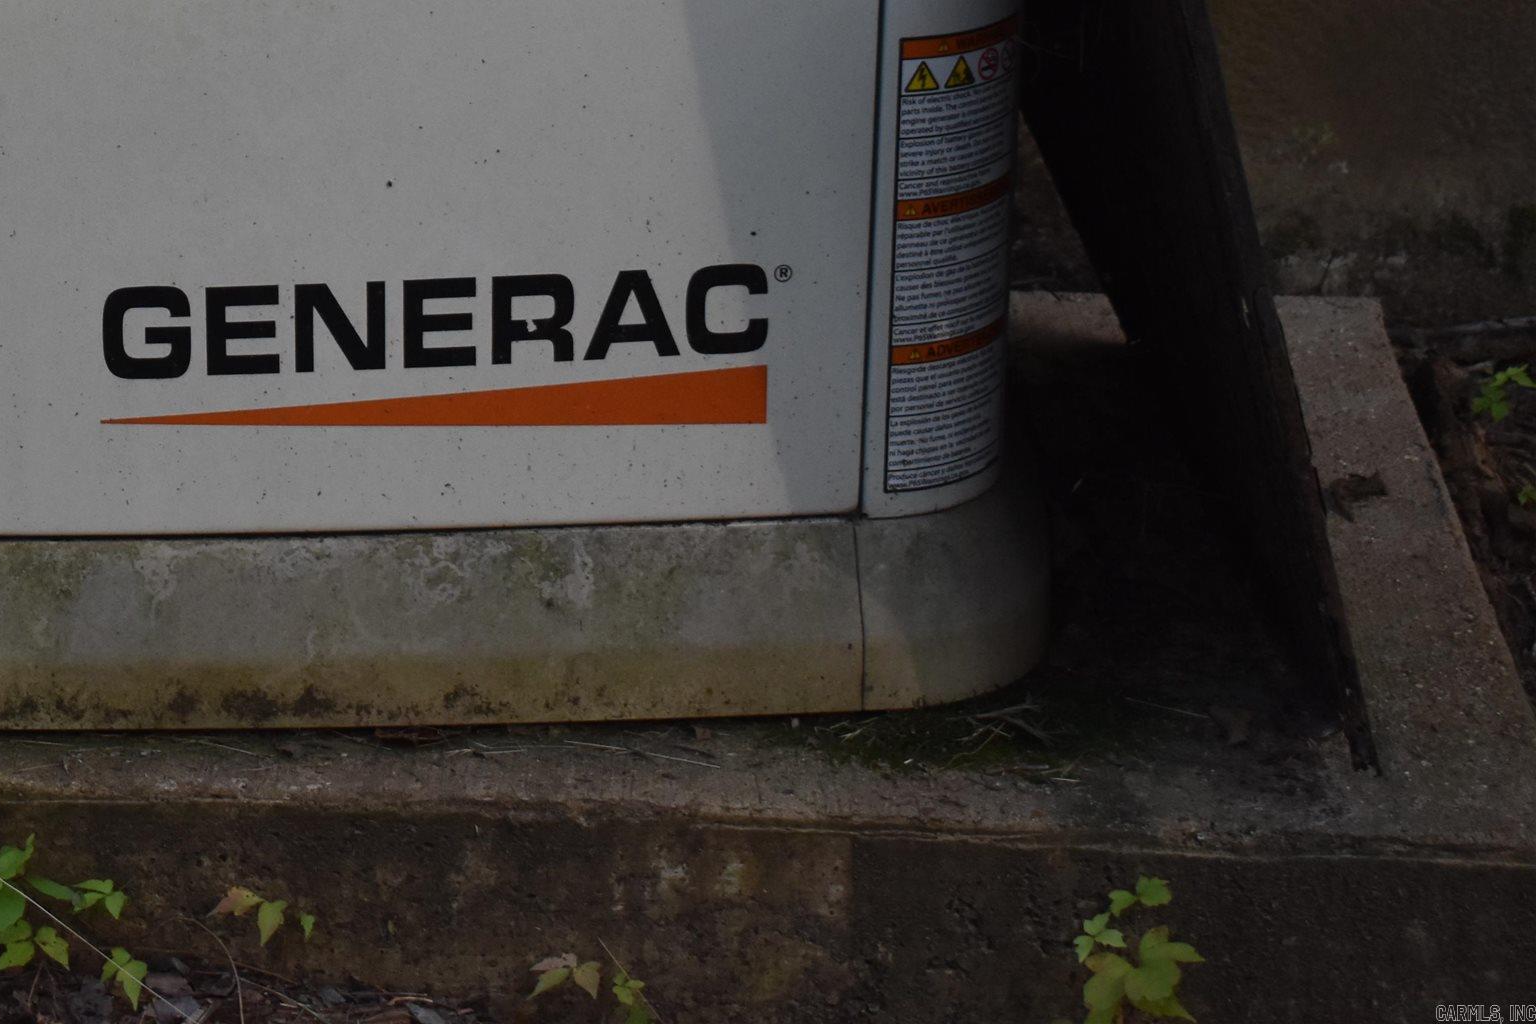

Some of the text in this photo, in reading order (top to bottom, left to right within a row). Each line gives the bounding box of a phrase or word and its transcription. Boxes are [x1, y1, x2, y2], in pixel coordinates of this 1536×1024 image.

[901, 139, 935, 148] Explosion
[922, 185, 1005, 215] AVERTISSE
[101, 263, 770, 379] GENERAC
